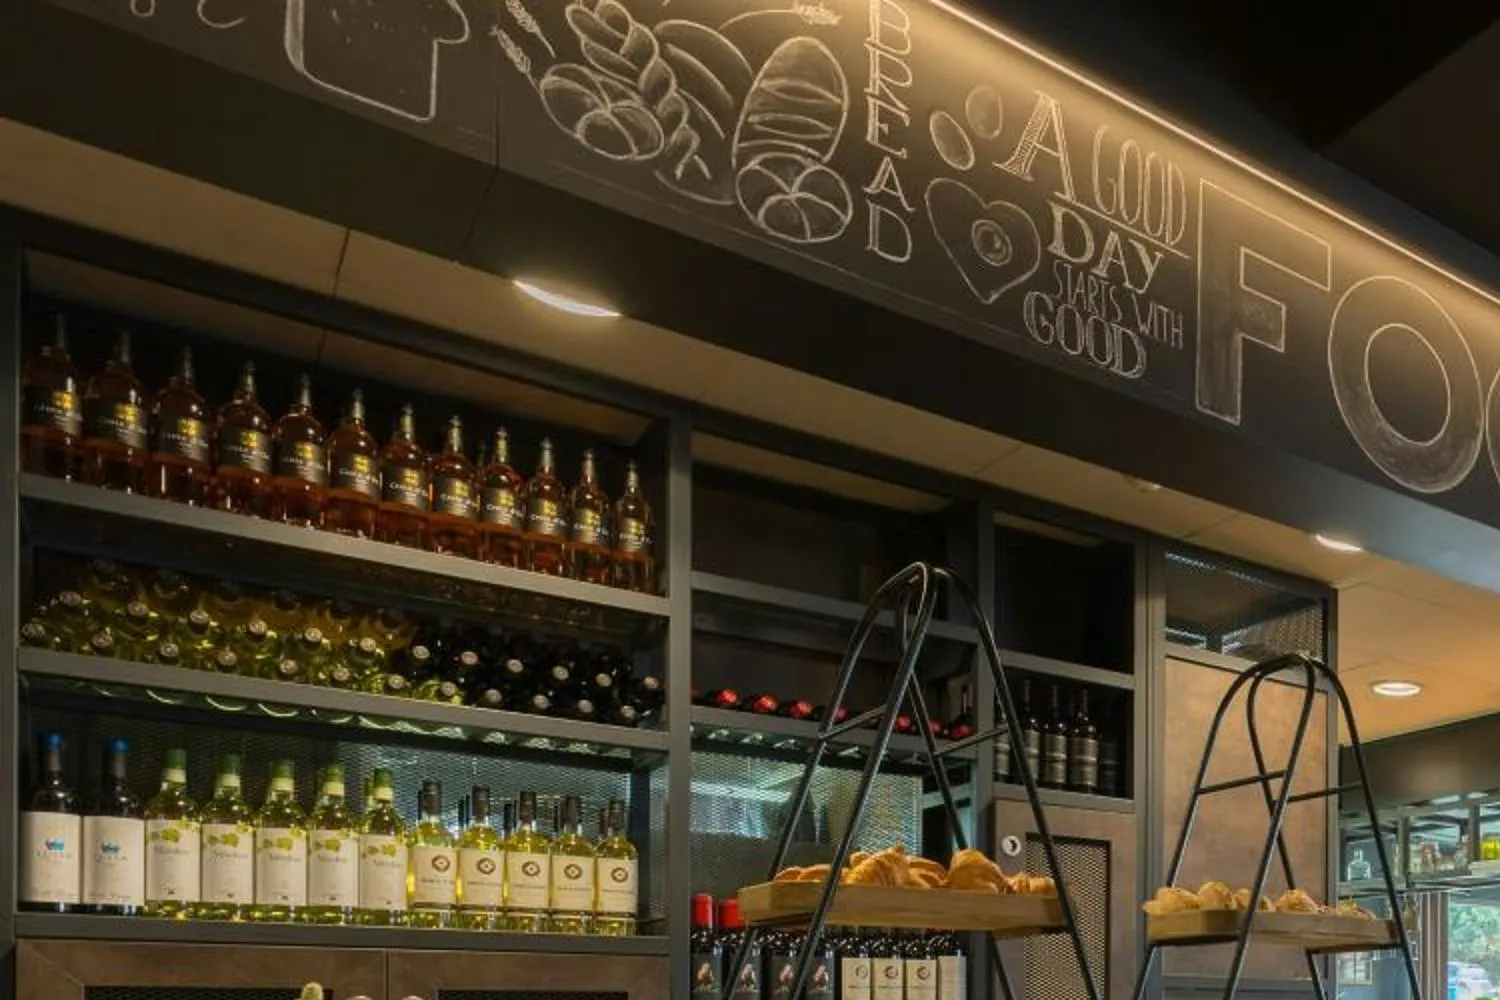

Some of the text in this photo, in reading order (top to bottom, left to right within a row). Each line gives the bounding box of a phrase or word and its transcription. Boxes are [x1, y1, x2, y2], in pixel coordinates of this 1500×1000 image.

[864, 0, 914, 262] BREAD
[992, 90, 1186, 247] A GOOD
[1047, 201, 1165, 295] DAY
[1023, 291, 1148, 379] GOOD
[1053, 259, 1184, 350] STARTS WITH
